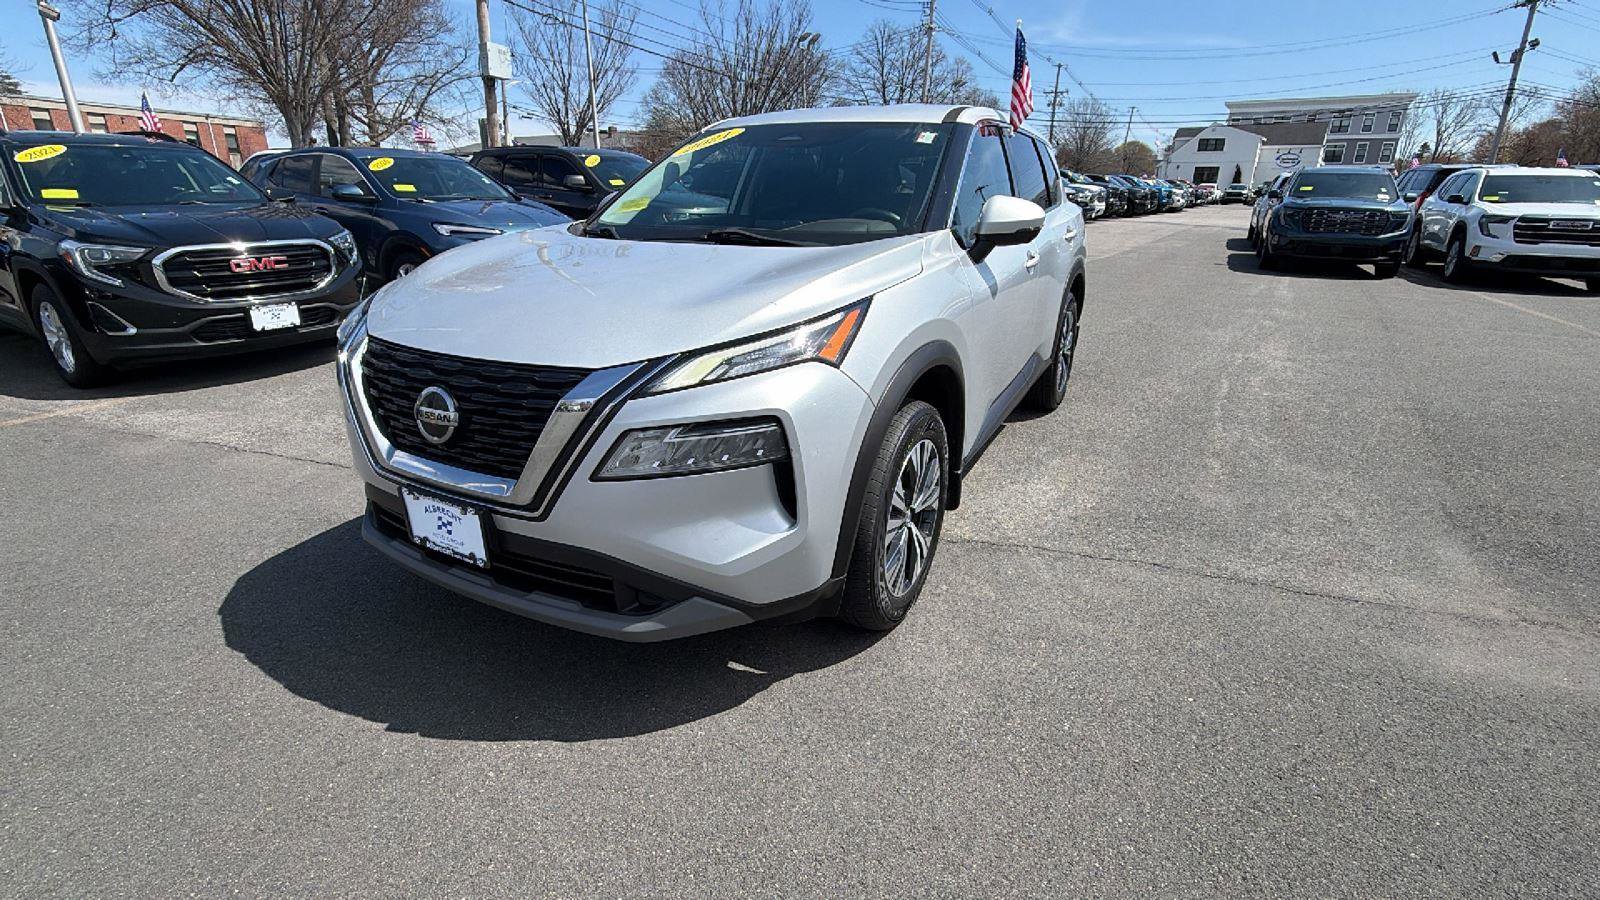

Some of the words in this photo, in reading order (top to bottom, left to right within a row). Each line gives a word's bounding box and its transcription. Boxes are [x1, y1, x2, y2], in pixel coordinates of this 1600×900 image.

[229, 256, 289, 272] GMC
[416, 408, 452, 423] NISSAN
[424, 504, 462, 525] ALBRECHT
